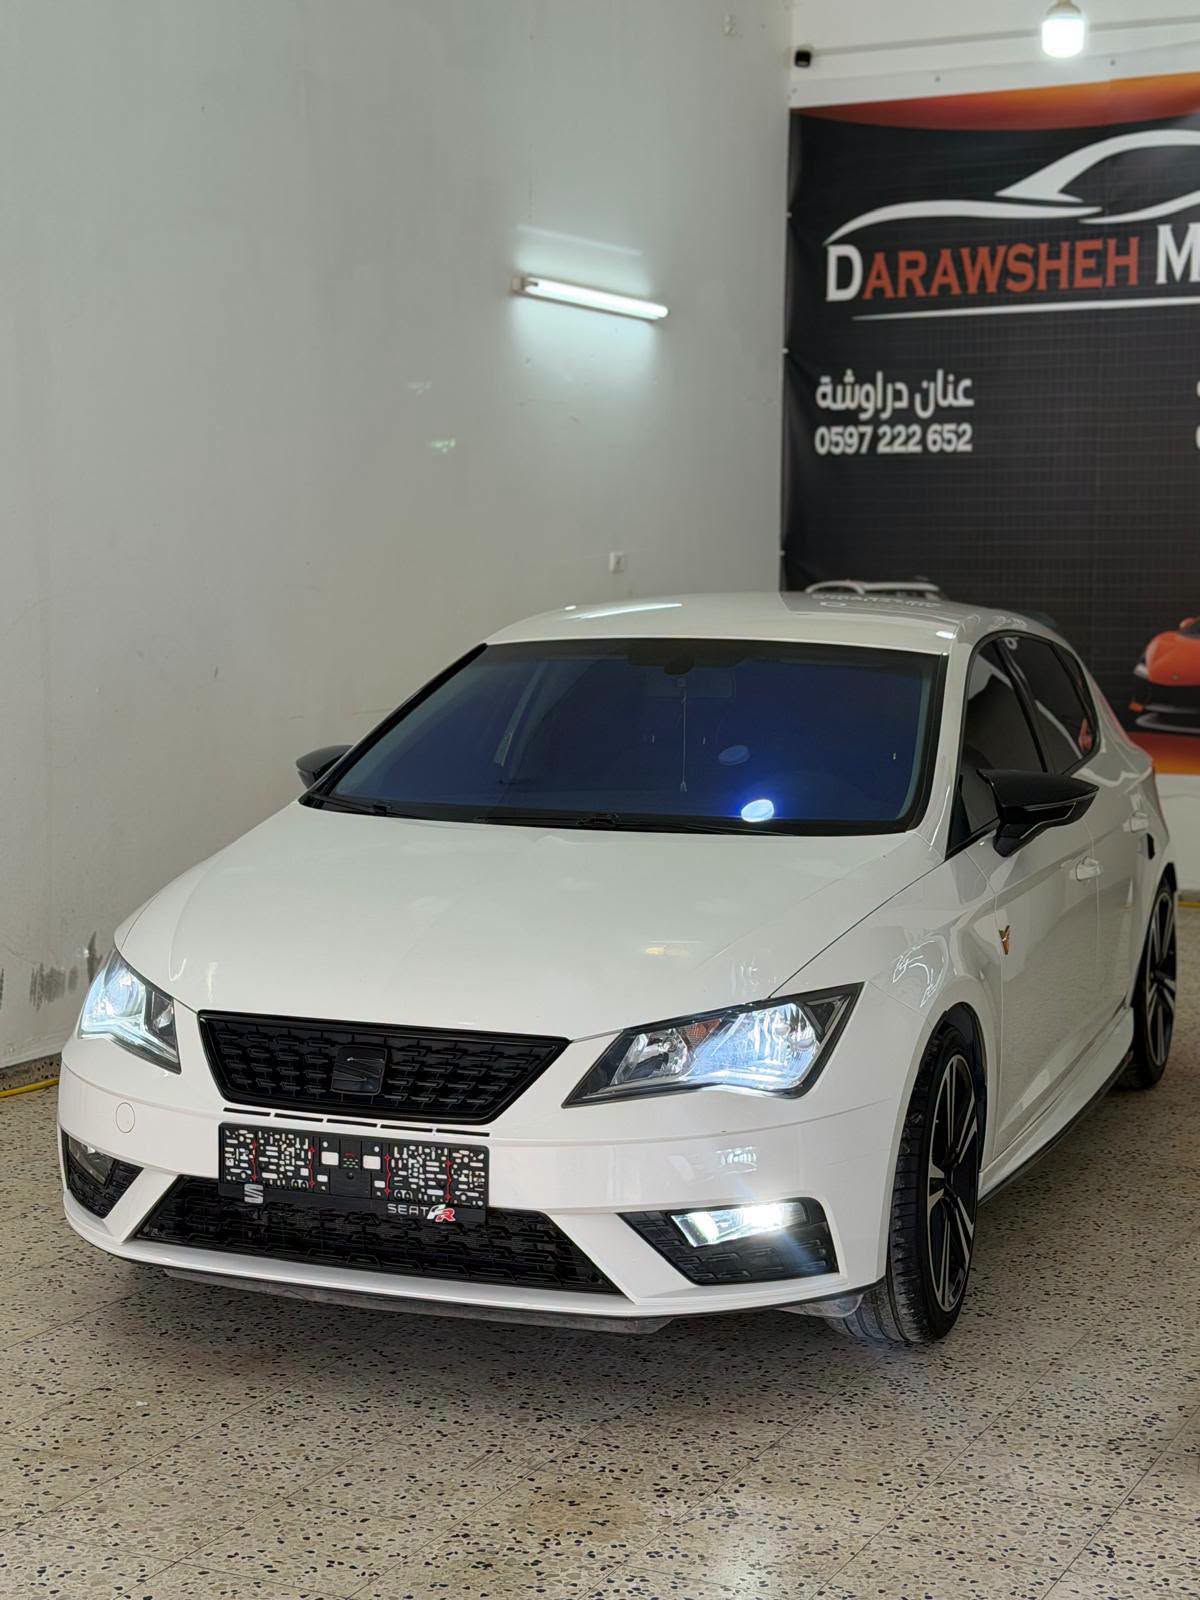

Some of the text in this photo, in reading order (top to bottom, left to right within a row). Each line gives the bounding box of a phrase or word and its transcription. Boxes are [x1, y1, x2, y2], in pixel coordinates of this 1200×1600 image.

[826, 236, 1140, 302] DARAWSHEH
[816, 369, 974, 420] عنان دراوشة
[814, 423, 973, 455] 0597 222 652
[387, 1203, 429, 1217] SEAT
